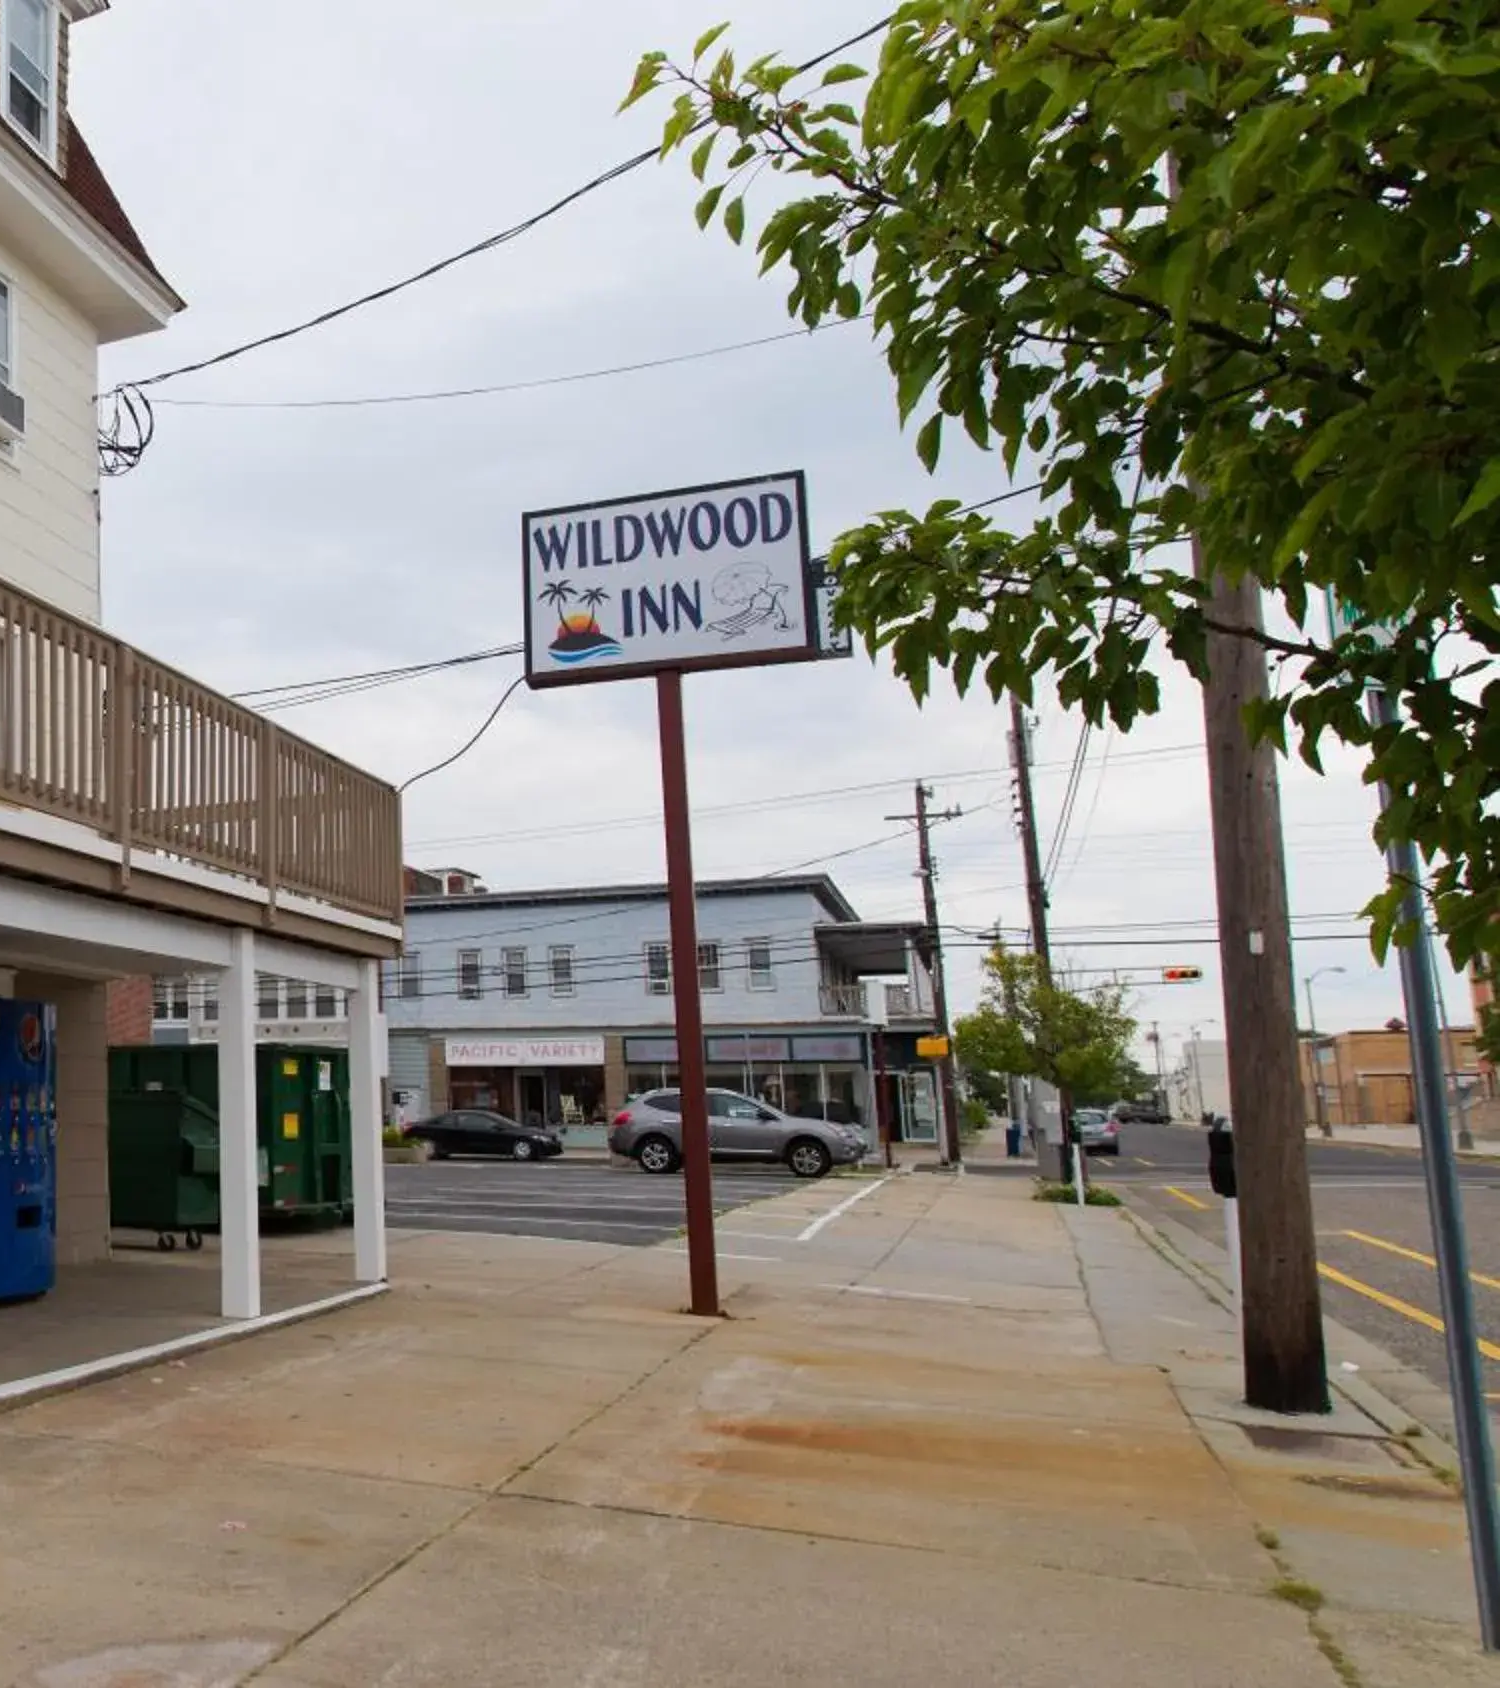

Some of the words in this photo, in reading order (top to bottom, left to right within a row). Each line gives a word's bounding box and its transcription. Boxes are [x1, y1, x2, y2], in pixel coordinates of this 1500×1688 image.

[532, 491, 793, 572] WILDWOOD
[621, 578, 705, 638] INN
[451, 1044, 518, 1058] PACIFIC
[529, 1043, 599, 1057] VARIETY
